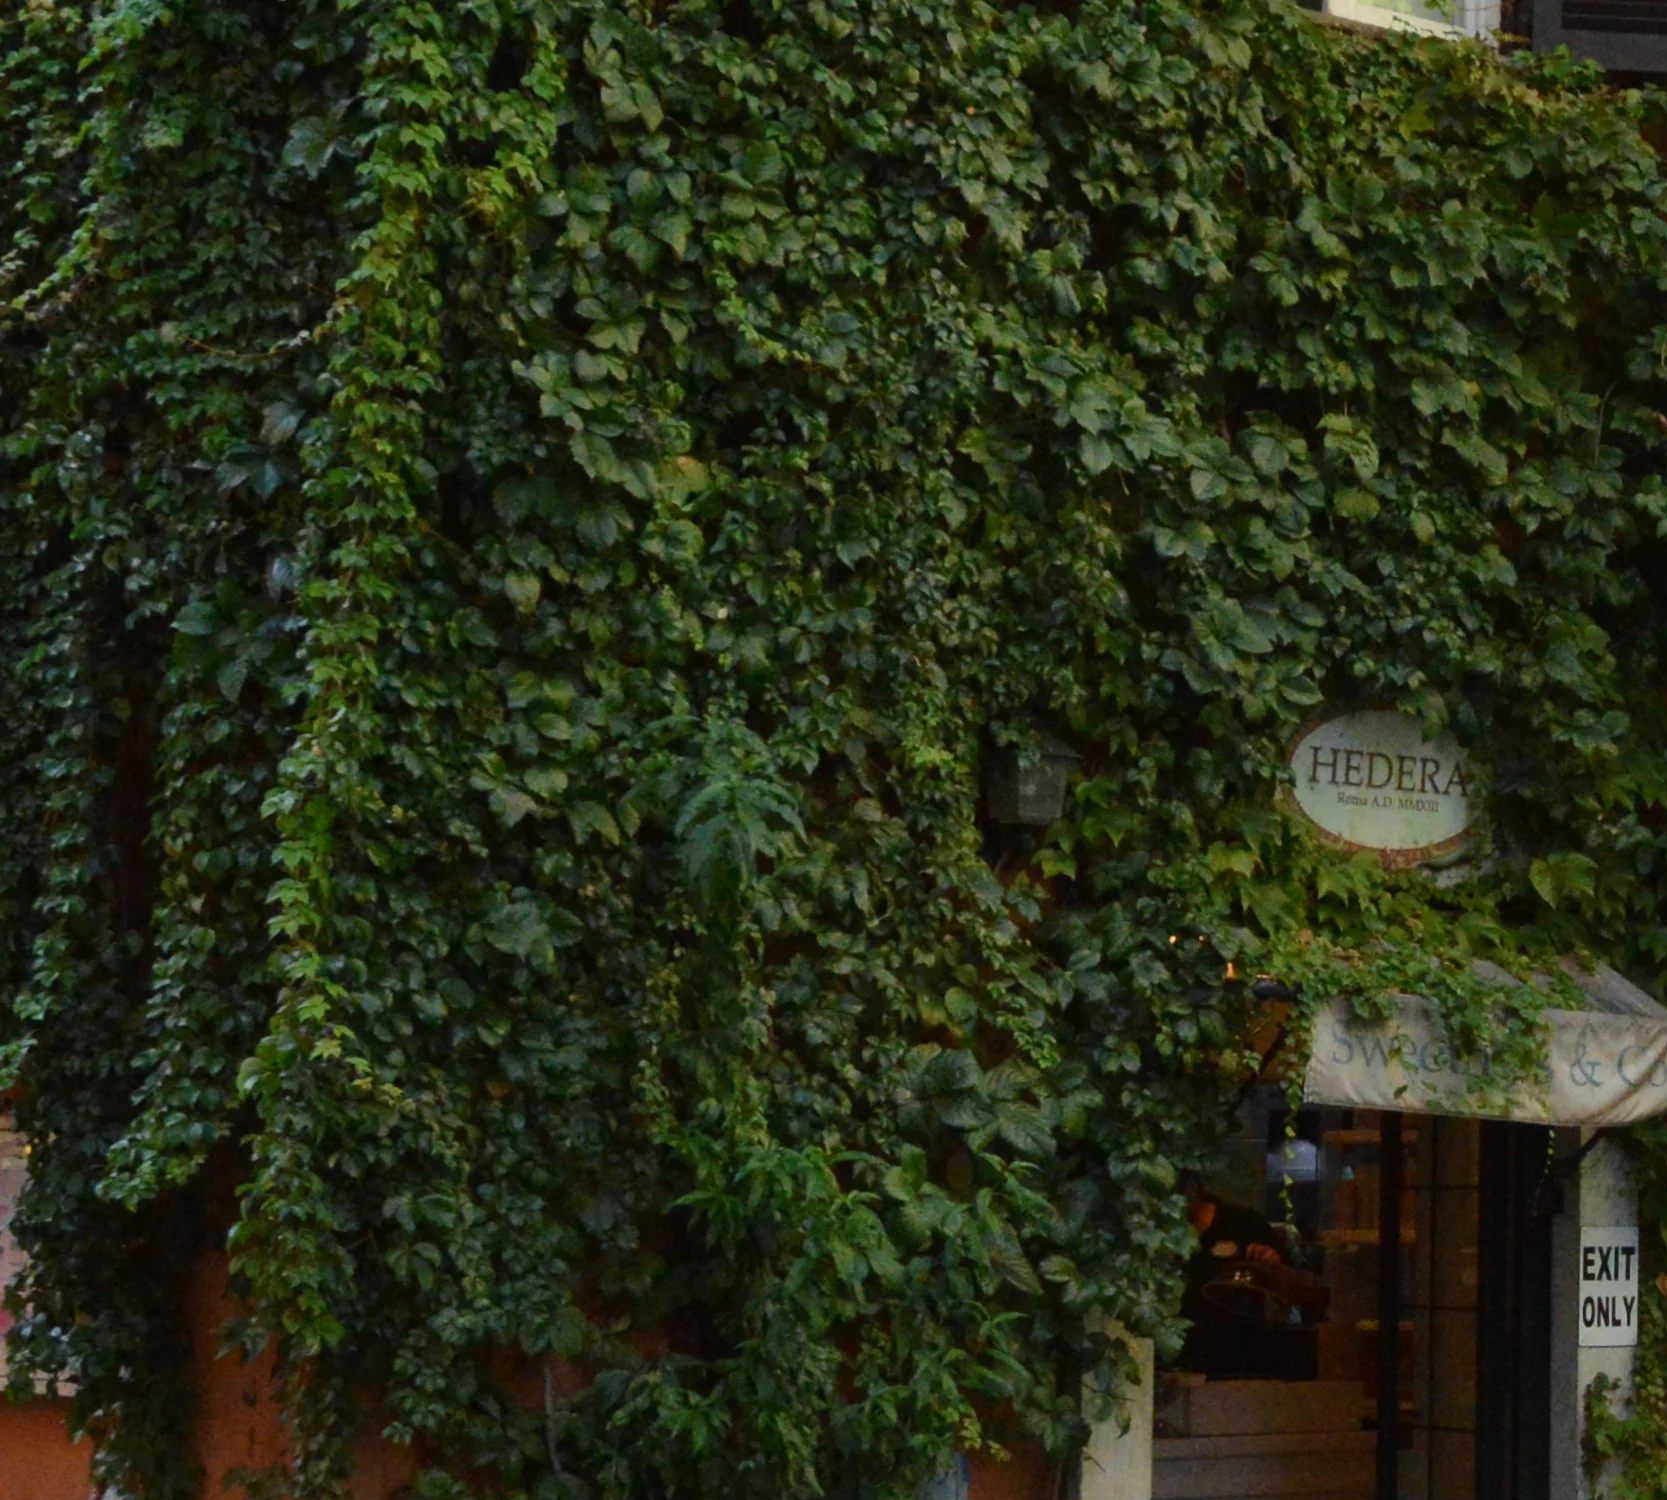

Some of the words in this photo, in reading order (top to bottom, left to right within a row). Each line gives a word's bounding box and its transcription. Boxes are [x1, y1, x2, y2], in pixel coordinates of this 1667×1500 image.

[1308, 745, 1469, 797] HEDERA
[1337, 792, 1368, 806] Roma
[1571, 1043, 1603, 1087] &
[1582, 1246, 1636, 1281] EXIT
[1582, 1295, 1636, 1328] ONLY
